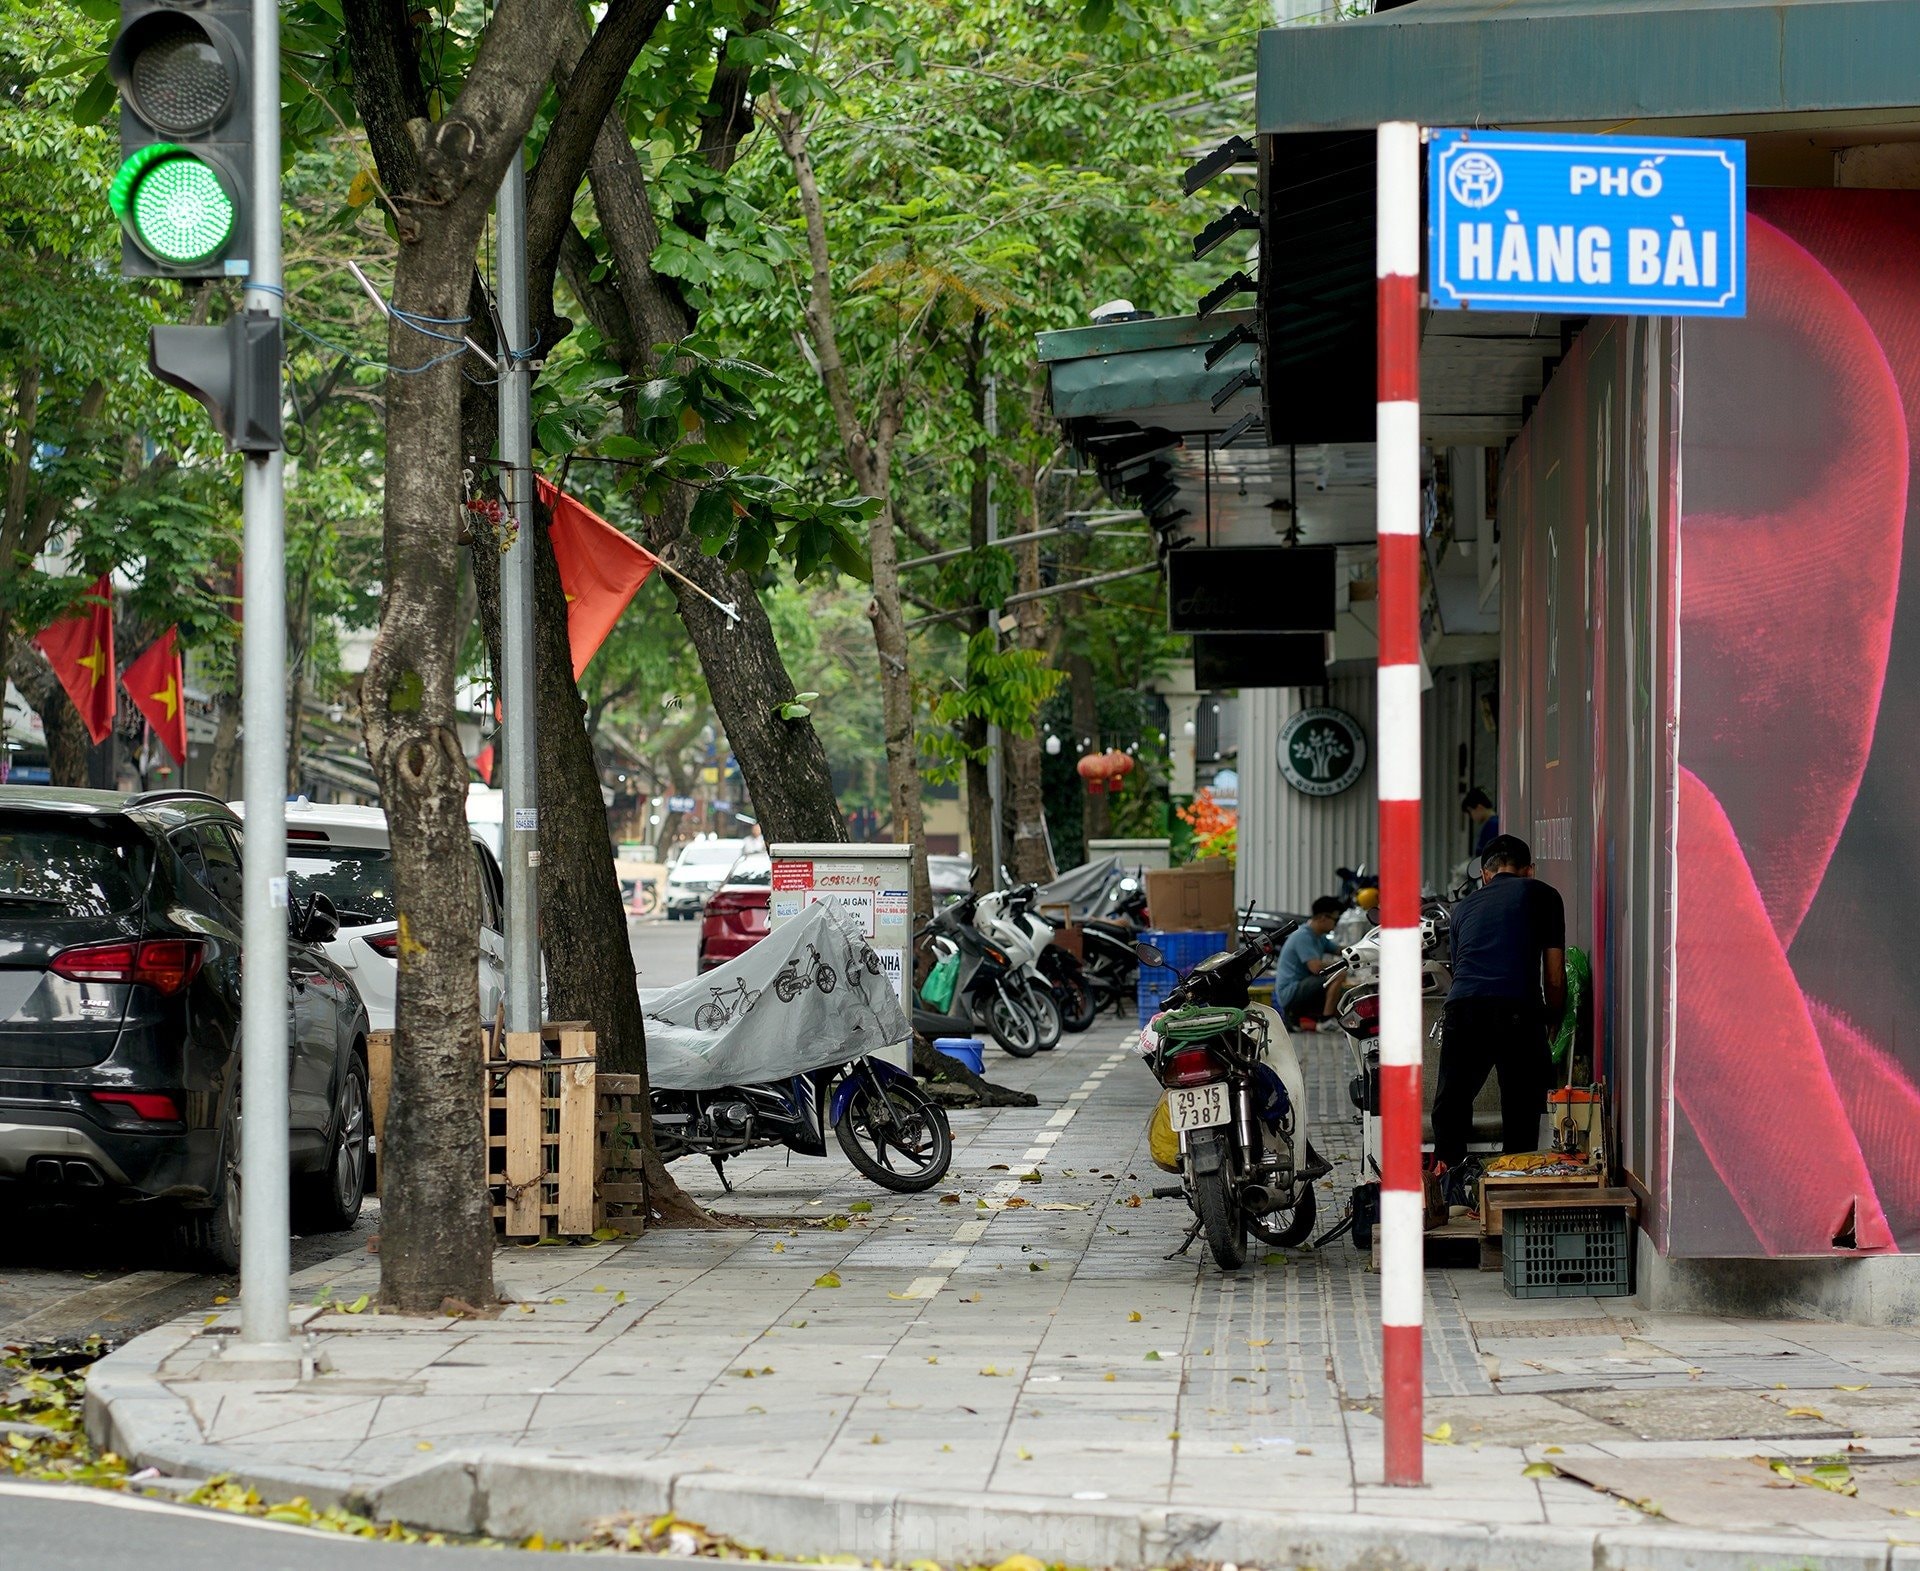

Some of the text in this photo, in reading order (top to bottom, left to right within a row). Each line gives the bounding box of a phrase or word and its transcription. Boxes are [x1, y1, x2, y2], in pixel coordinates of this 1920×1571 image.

[1569, 156, 1667, 197] PHỐ
[1458, 209, 1717, 287] HÀNG BÀI
[1178, 1087, 1220, 1109] 29-Y5
[1180, 1105, 1220, 1128] 7387
